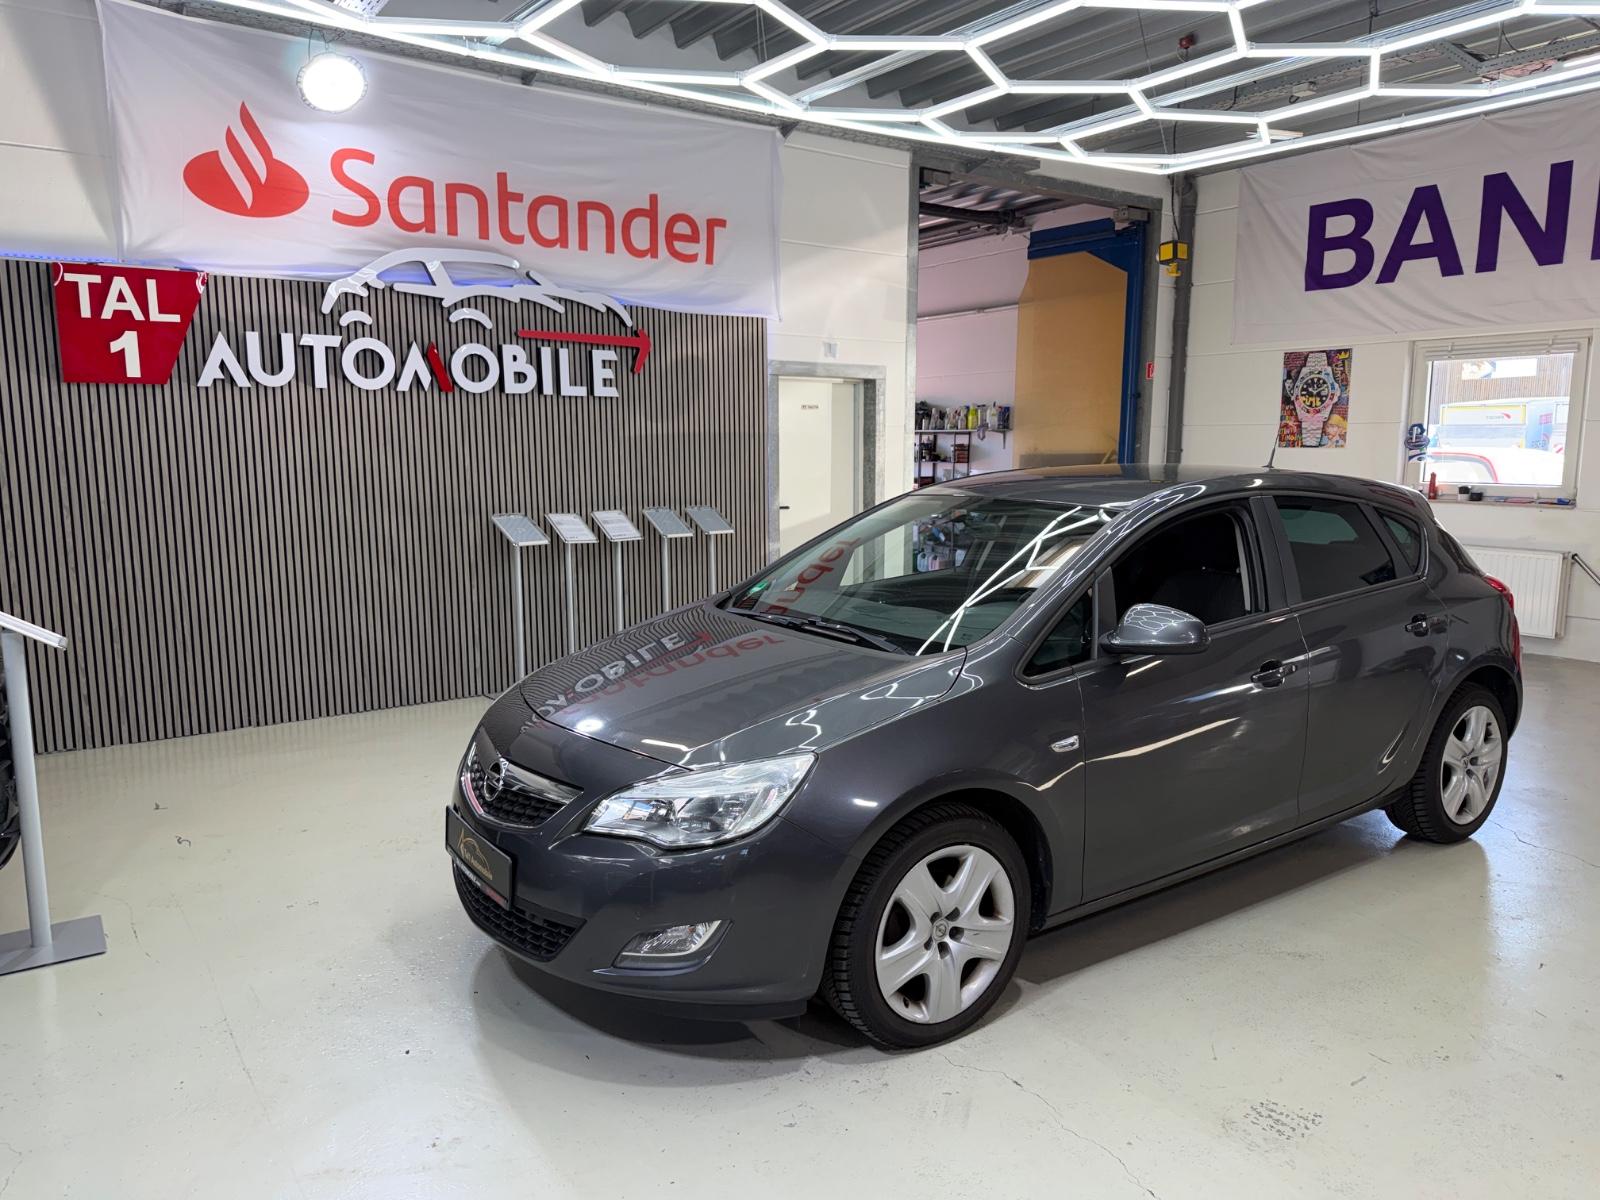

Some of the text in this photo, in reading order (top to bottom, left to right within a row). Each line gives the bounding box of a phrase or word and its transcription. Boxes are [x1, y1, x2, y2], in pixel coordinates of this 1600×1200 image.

[330, 147, 727, 266] Santander
[1305, 160, 1600, 291] BAN
[63, 272, 181, 323] TAL
[109, 330, 142, 378] 1
[197, 331, 620, 397] AUTOMOBILE
